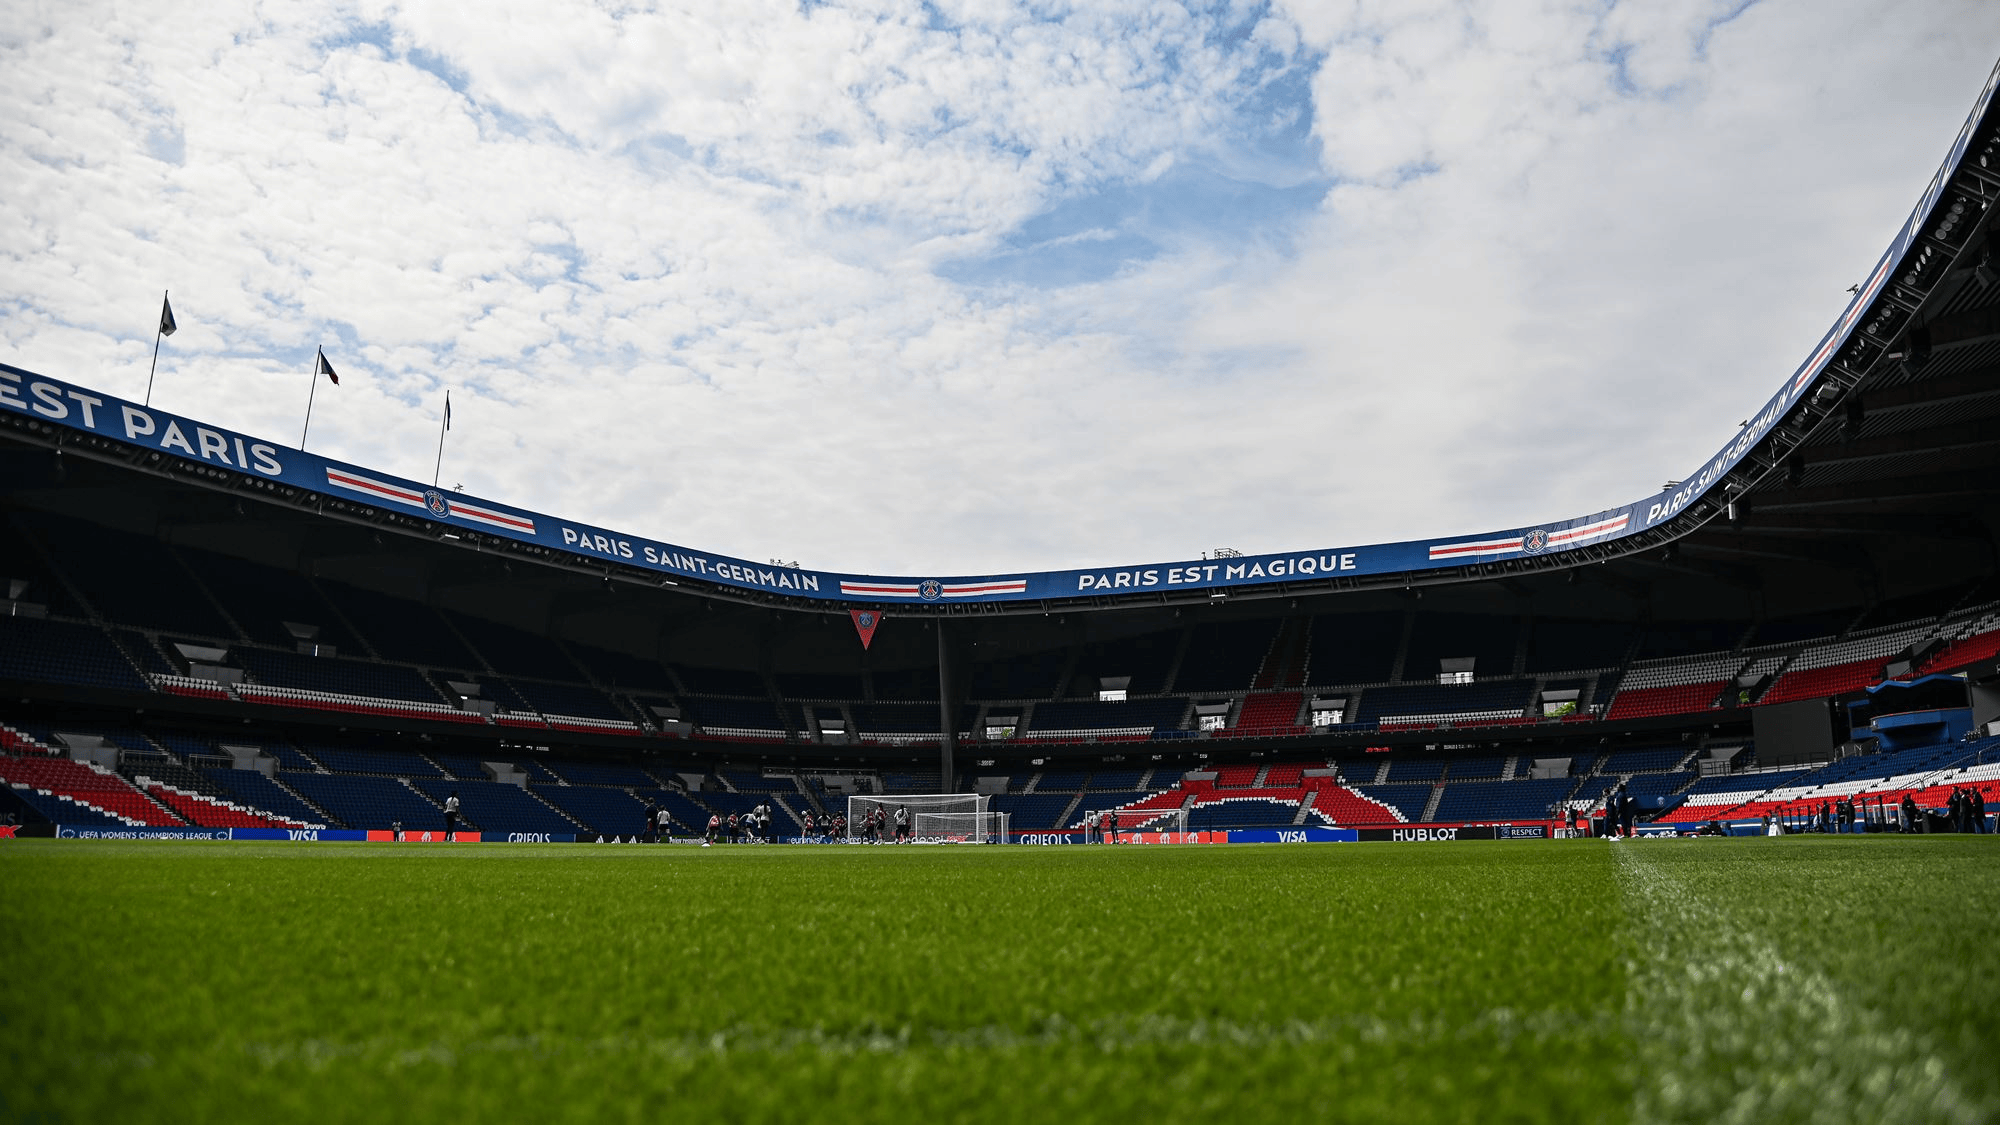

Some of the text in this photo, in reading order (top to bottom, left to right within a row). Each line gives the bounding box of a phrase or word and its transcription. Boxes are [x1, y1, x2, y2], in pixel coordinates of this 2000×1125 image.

[0, 370, 282, 476] EST PARIS
[1646, 384, 1792, 525] PARIS SAINT-GERMAIN
[562, 527, 823, 592] PARIS SAINT-GERMAIN
[1078, 553, 1356, 591] PARIS EST MAGIQUE
[79, 831, 213, 840] UEFA WOMEN'S CHAMPIONS LEAGUE
[286, 829, 318, 841] VISA
[1020, 833, 1071, 844] GRIFOLS
[1276, 830, 1308, 843] VISA
[1392, 828, 1458, 841] HUBLOT
[1511, 828, 1543, 838] RESPECT
